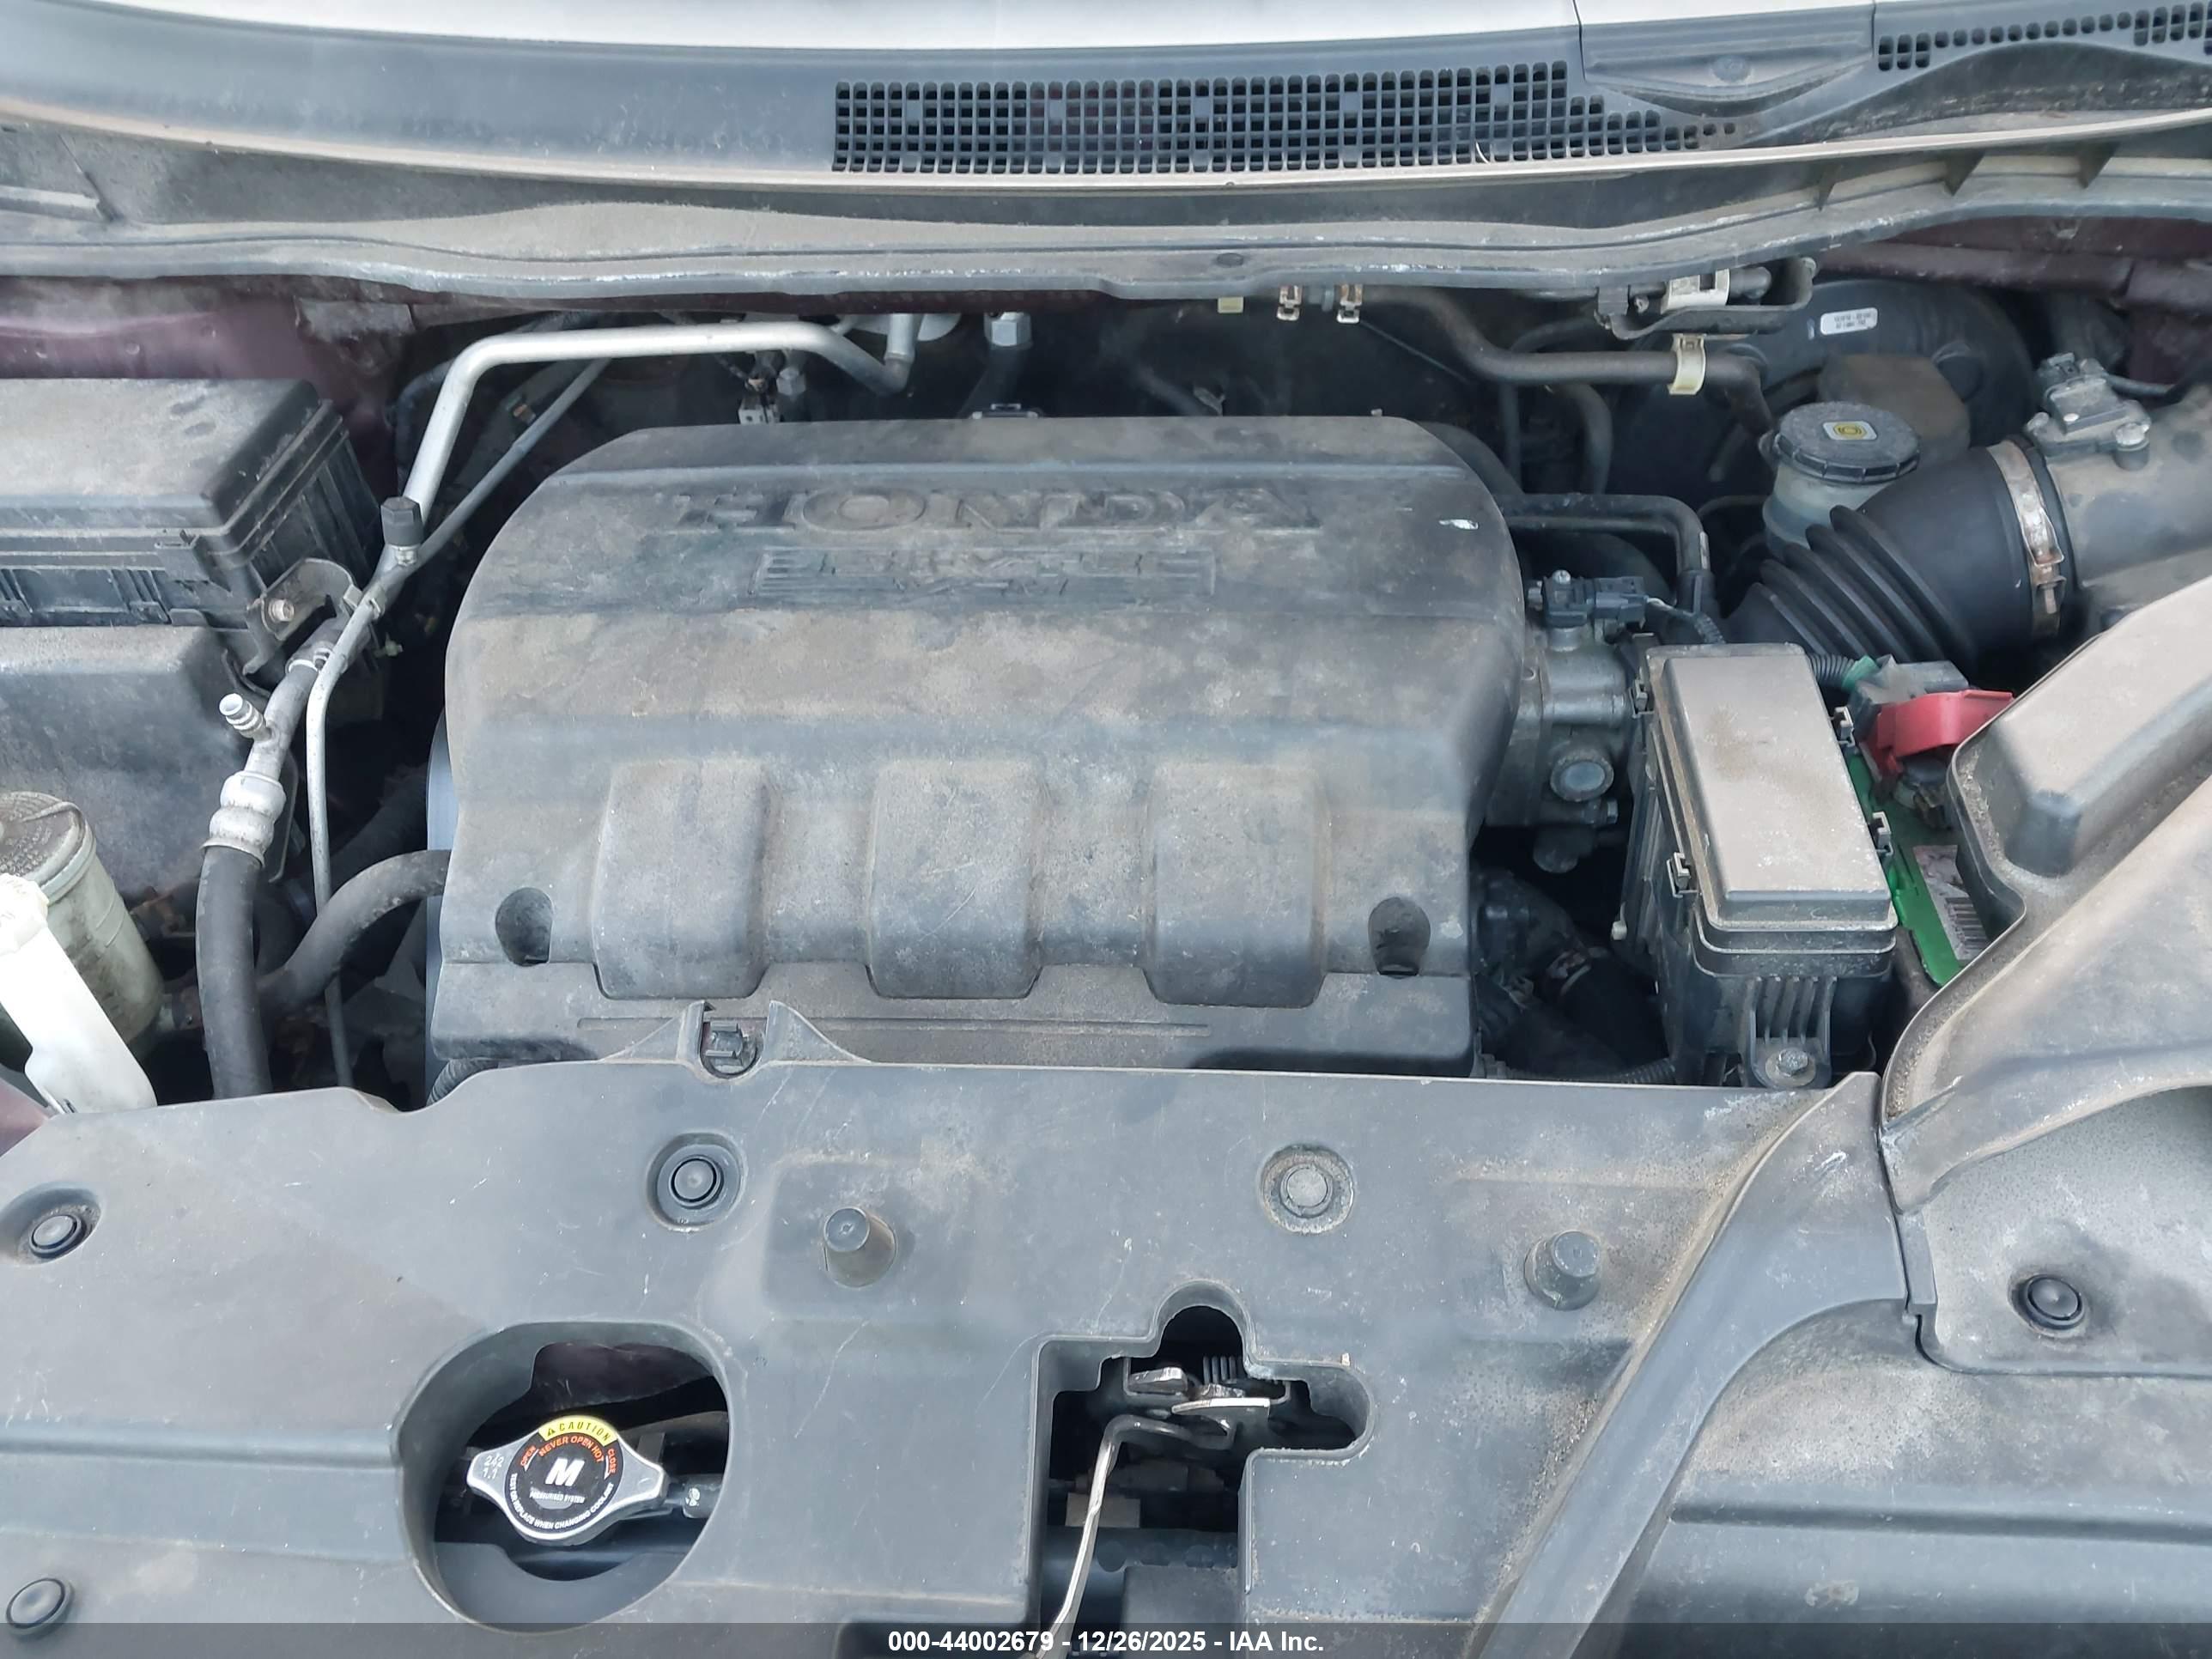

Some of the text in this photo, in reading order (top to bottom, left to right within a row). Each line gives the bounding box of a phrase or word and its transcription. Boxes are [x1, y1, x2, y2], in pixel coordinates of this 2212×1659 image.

[668, 486, 1322, 534] HONDA
[559, 1421, 611, 1442] CAUTION
[520, 1445, 537, 1467] OPEN
[538, 1435, 605, 1463] NEVER OPEN HOT
[607, 1448, 617, 1474] CLOSE
[544, 1457, 586, 1487] M
[509, 1473, 614, 1529] TEST OR REPLACE WHEN CHANGING COOLANT
[563, 1493, 586, 1504] SYSTEM
